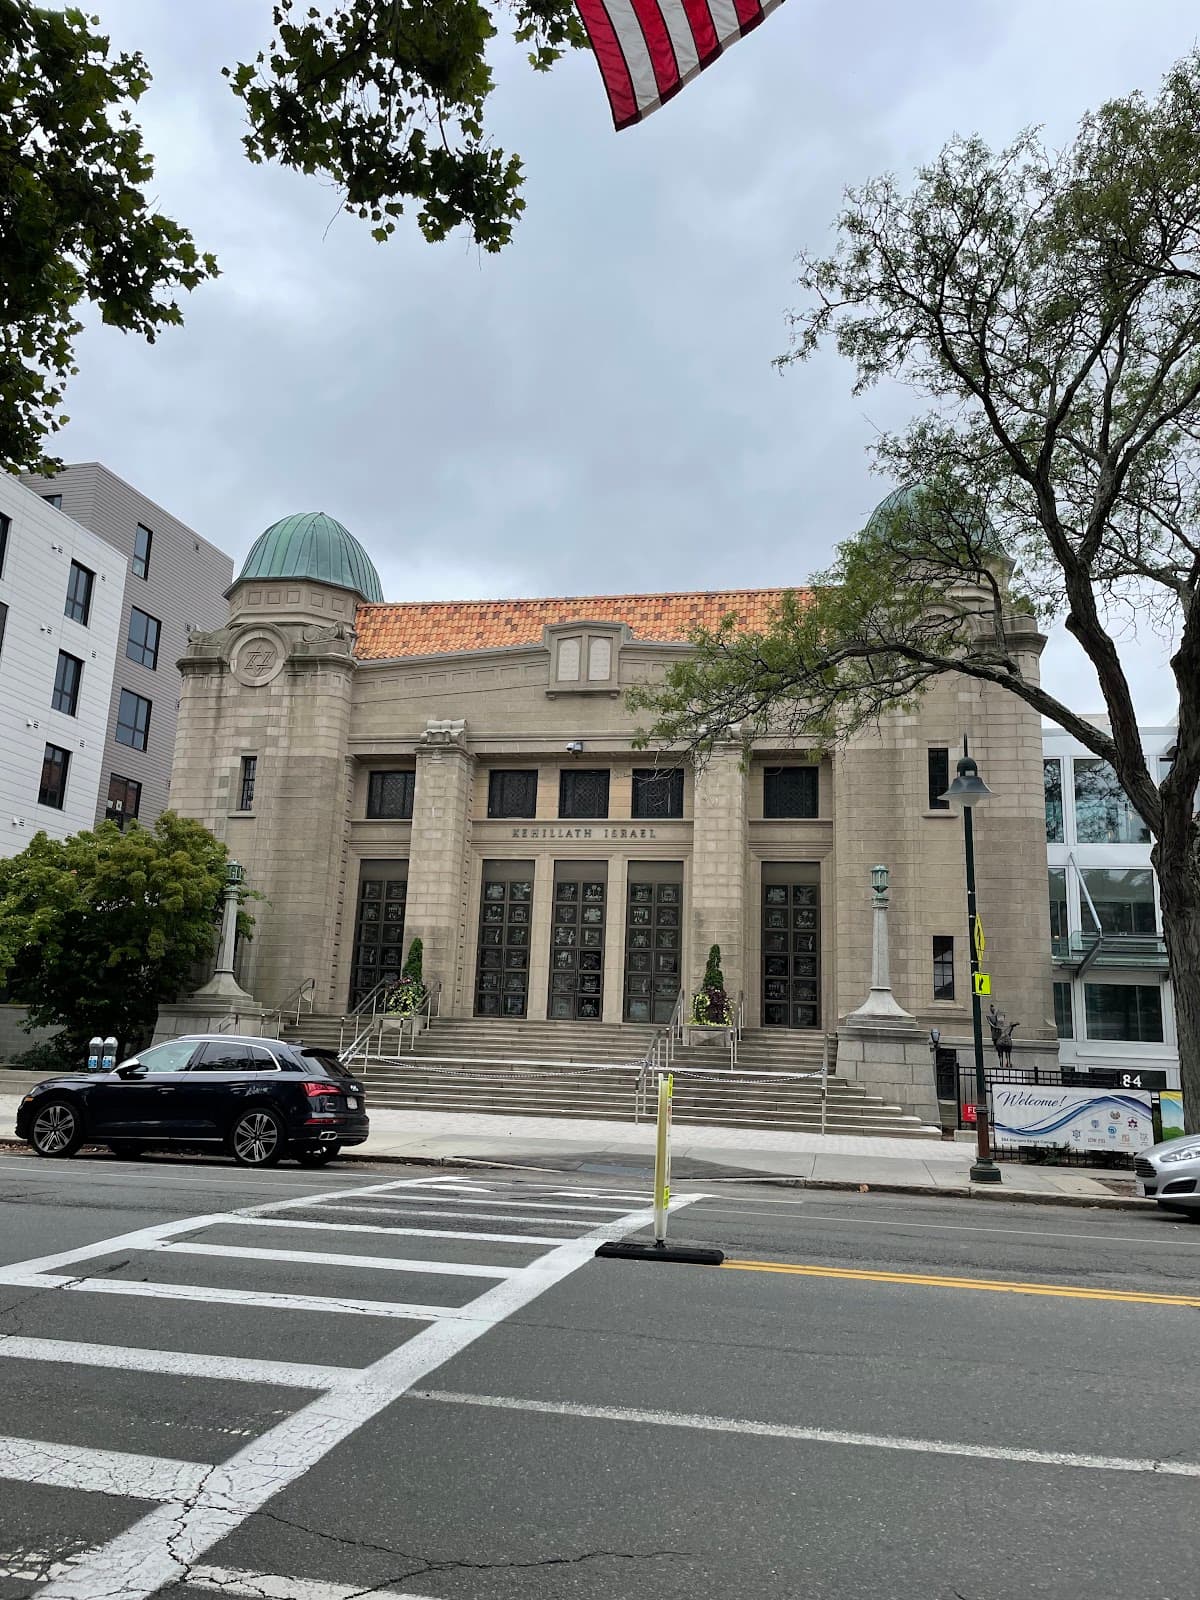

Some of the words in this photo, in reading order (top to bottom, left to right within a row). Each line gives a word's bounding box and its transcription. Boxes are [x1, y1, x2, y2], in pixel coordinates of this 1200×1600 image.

[512, 828, 592, 839] KEHILLATH
[604, 828, 657, 839] ISRAEL
[1119, 1074, 1142, 1088] 84
[996, 1091, 1067, 1107] Welcome!
